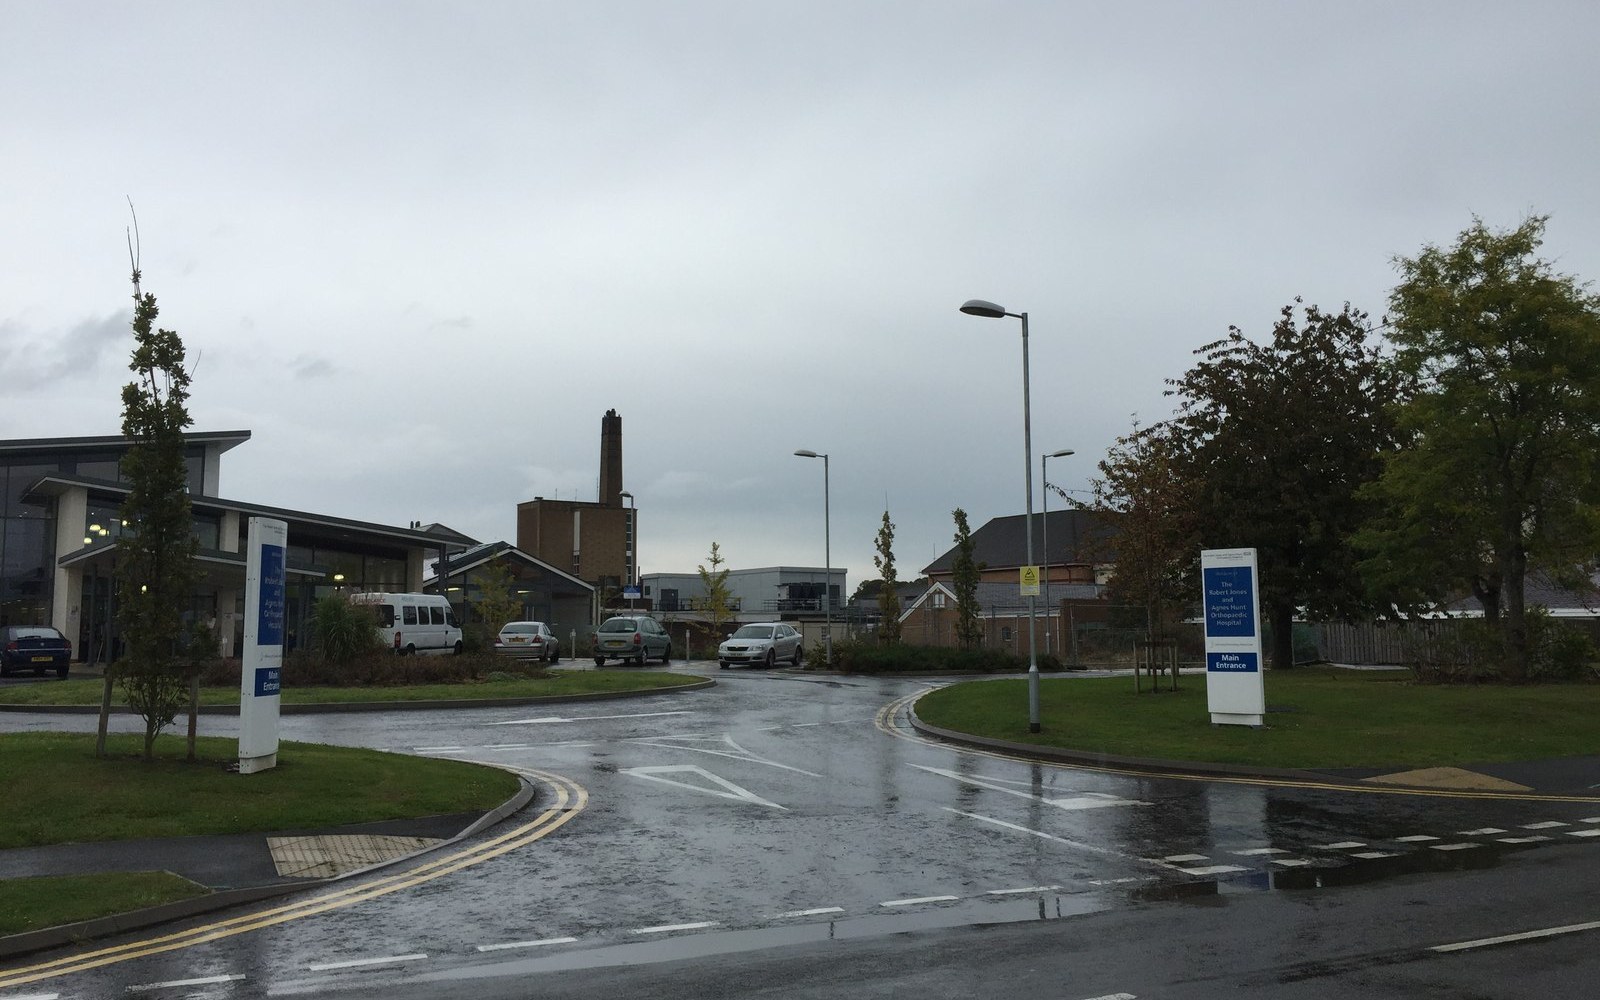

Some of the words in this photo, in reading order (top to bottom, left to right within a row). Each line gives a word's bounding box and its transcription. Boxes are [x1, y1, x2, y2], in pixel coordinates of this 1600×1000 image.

[1211, 604, 1229, 612] Agnes
[1221, 654, 1240, 662] Main
[1215, 661, 1247, 669] Entrance
